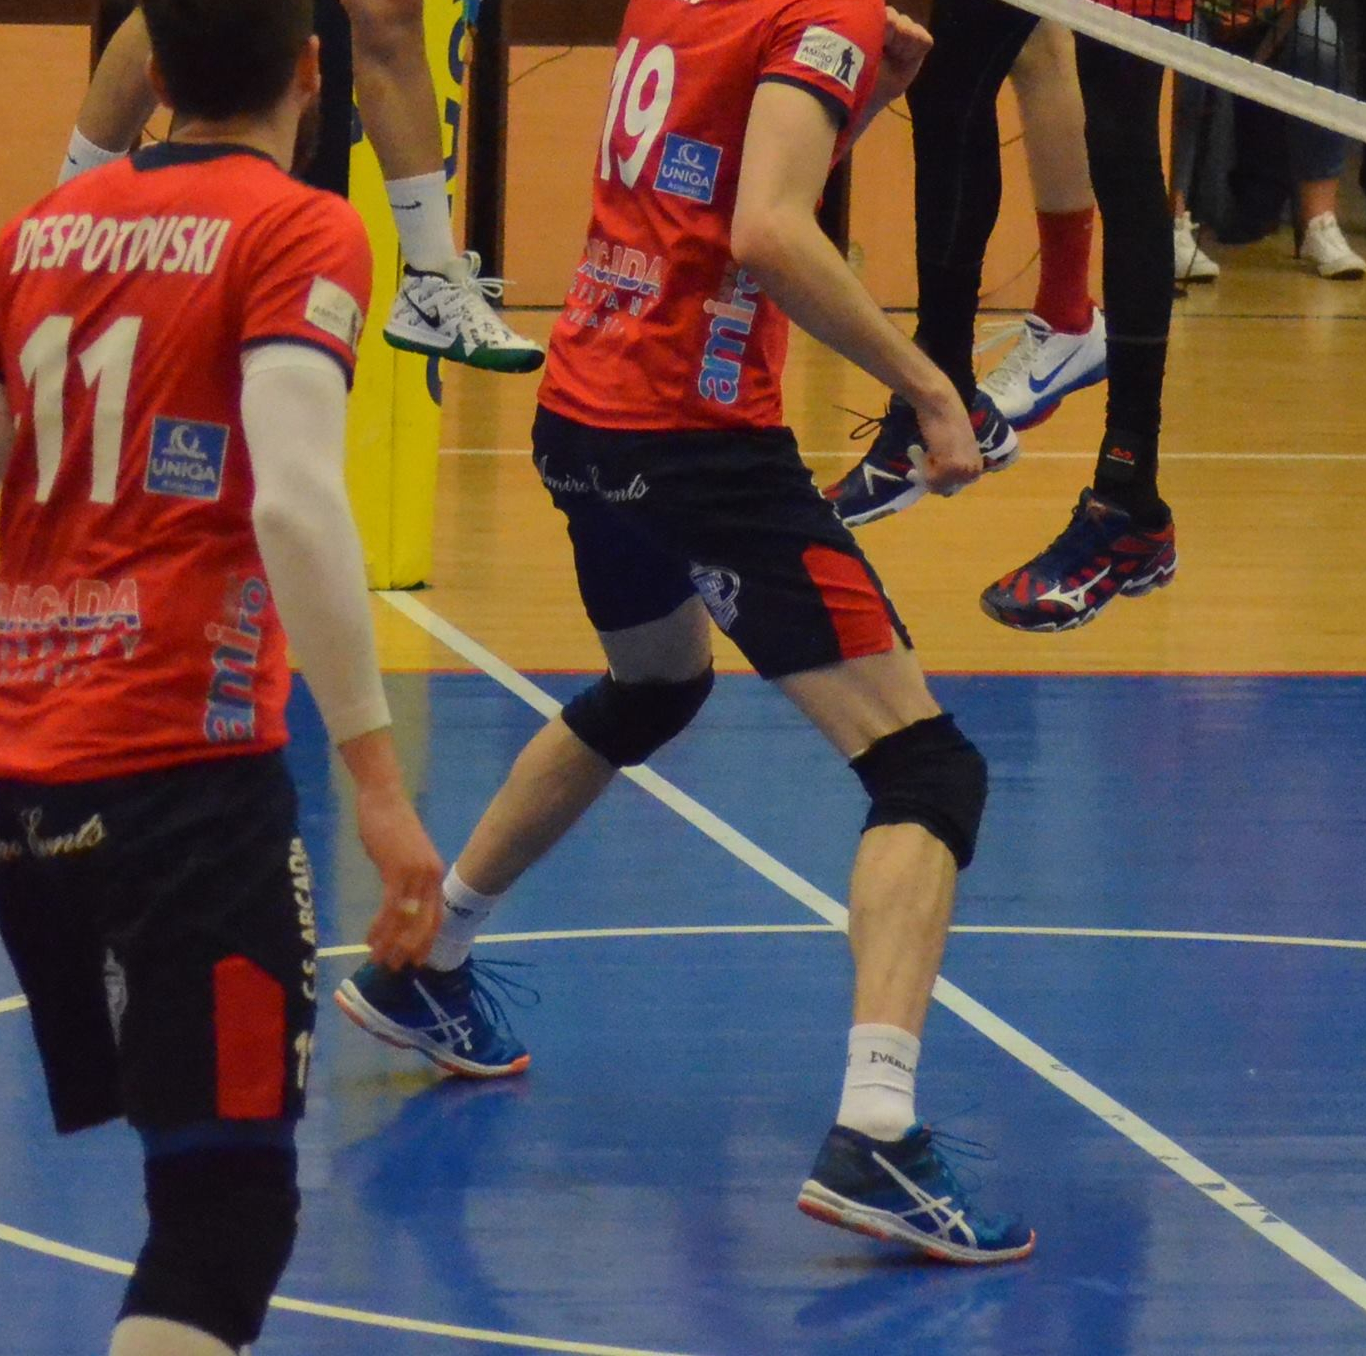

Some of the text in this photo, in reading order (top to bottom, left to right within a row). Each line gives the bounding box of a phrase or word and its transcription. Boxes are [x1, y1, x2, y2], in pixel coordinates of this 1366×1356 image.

[600, 37, 676, 188] 19
[662, 164, 710, 189] UNIQA
[20, 314, 143, 505] 11
[152, 458, 216, 482] UNIQA
